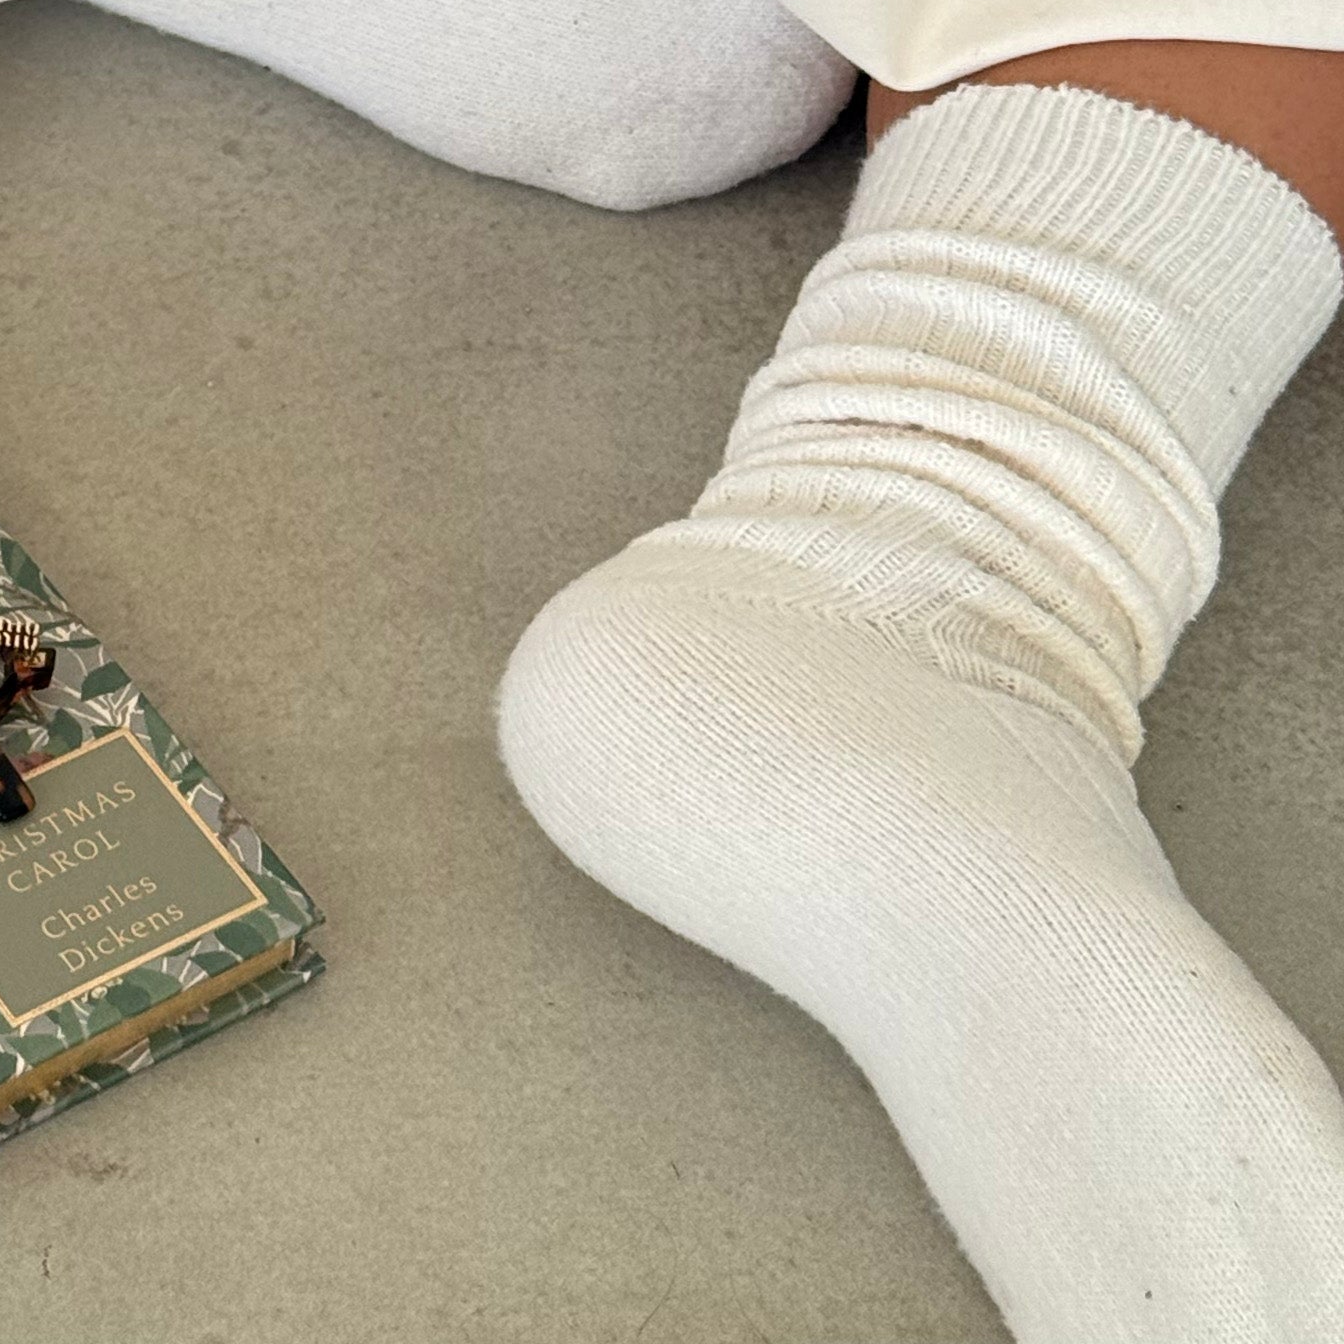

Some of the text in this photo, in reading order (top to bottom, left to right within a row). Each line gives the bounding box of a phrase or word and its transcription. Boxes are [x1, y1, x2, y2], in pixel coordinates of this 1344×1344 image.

[6, 828, 121, 894] CAROL
[40, 873, 158, 940] Charles
[58, 902, 185, 974] Dickens
